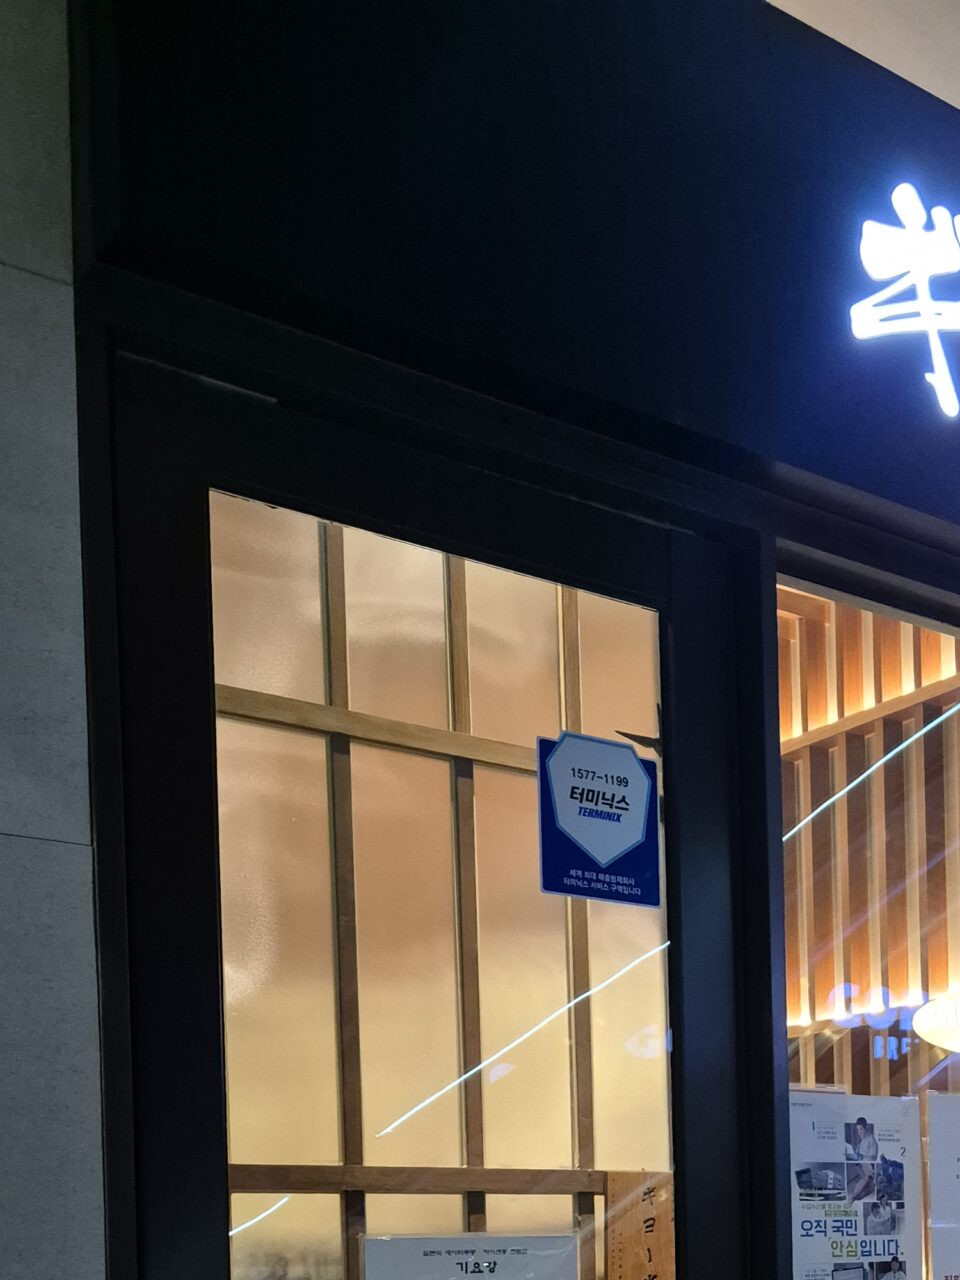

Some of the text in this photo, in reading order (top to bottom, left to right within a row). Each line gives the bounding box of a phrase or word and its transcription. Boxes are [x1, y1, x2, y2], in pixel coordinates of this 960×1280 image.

[571, 768, 629, 788] 1577-1199
[569, 785, 630, 811] 터미닉스
[577, 806, 623, 823] TERMINIX
[563, 877, 589, 888] 터미닉스
[800, 1218, 858, 1238] 오직 국민
